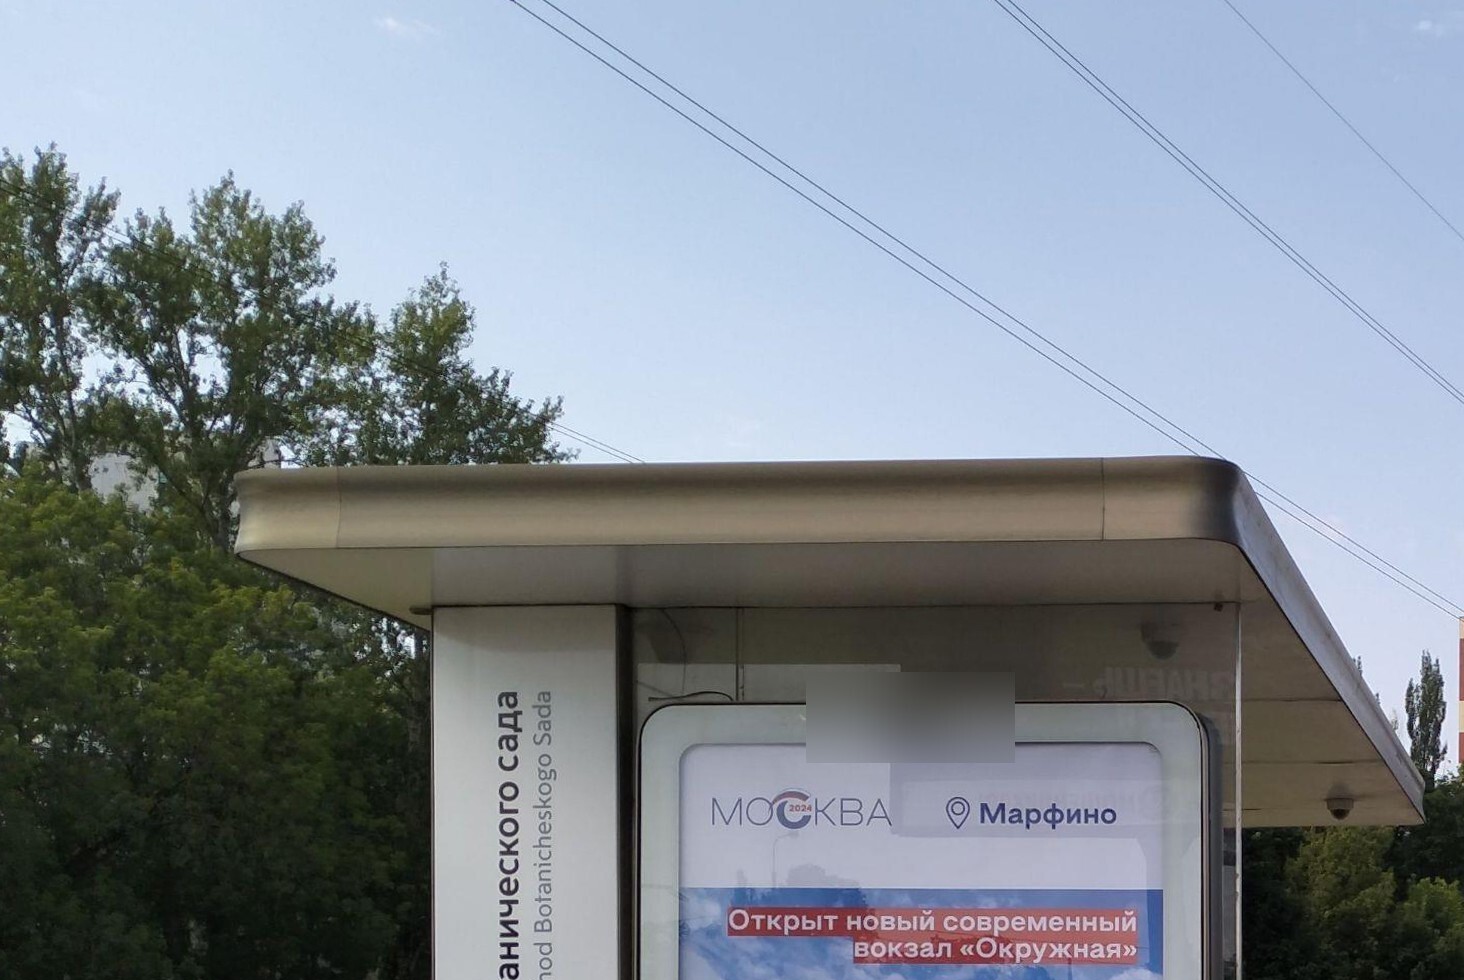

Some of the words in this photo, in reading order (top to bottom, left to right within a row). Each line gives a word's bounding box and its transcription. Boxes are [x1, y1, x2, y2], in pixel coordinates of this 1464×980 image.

[497, 691, 523, 772] сада
[532, 691, 552, 747] Sada
[711, 790, 893, 830] МОСКВА
[788, 804, 813, 813] 2024
[980, 801, 1118, 830] Марфино
[532, 753, 558, 933] Botanicheskogo
[730, 909, 838, 935] Открыт
[846, 910, 935, 931] новый
[942, 910, 1137, 935] современный
[854, 941, 953, 958] вокзал
[959, 937, 1137, 964] «Окружная»
